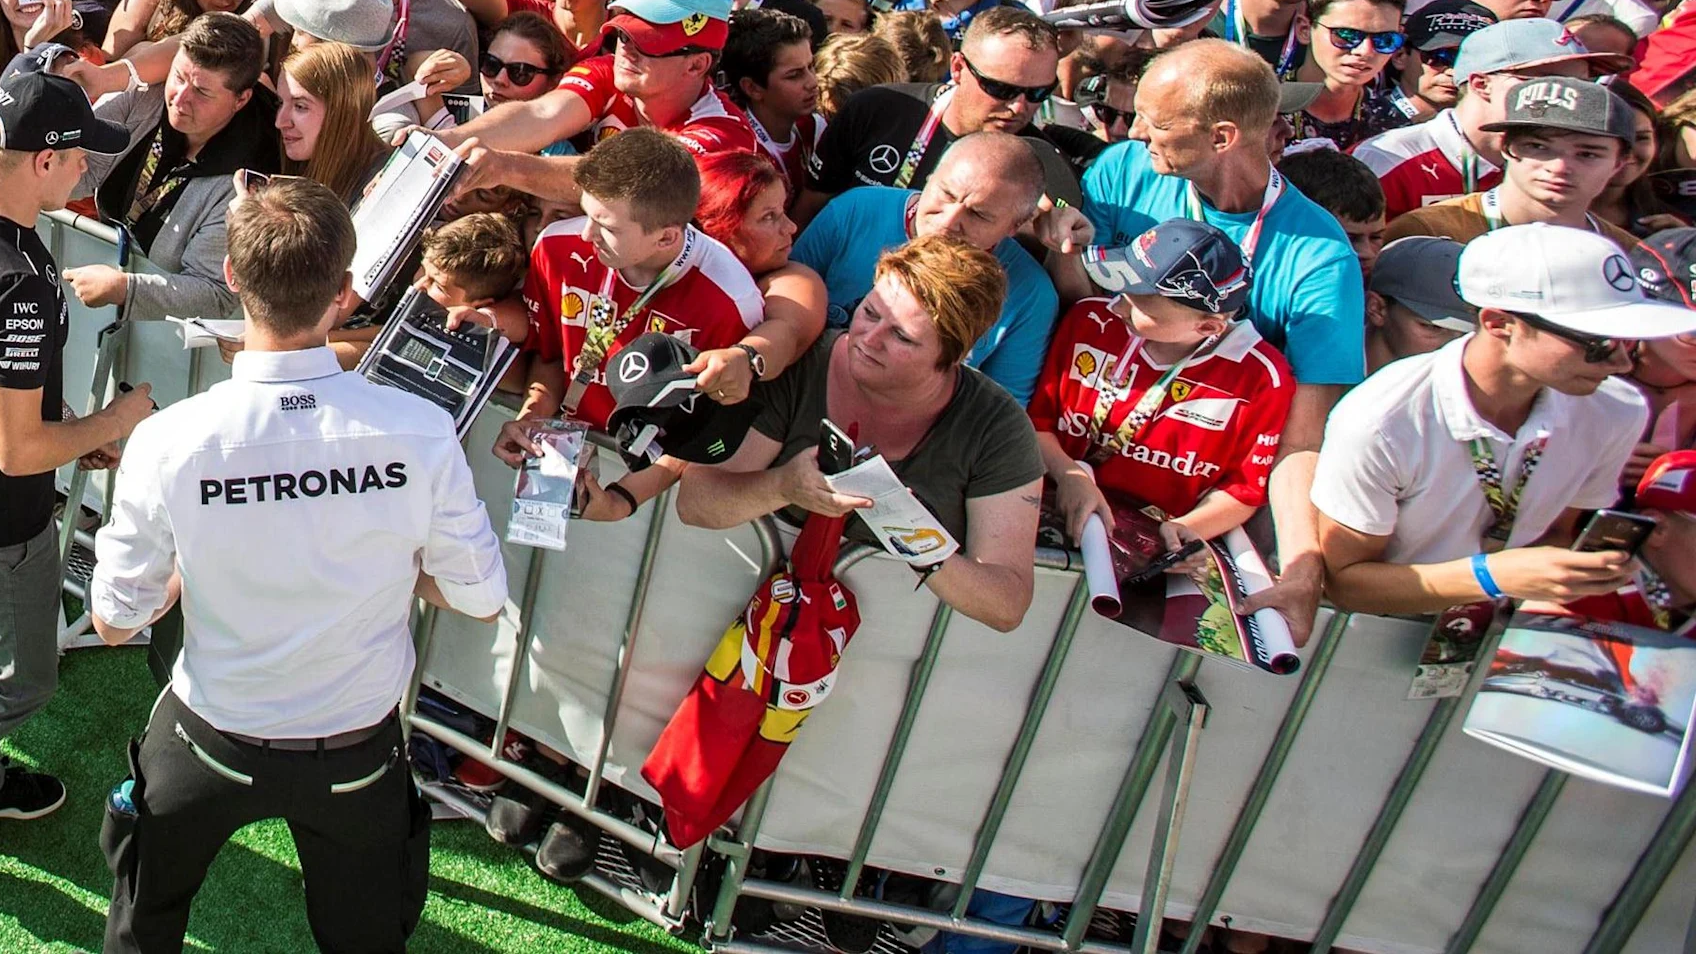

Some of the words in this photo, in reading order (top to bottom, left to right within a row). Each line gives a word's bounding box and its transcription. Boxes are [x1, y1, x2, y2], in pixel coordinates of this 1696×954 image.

[1515, 81, 1579, 111] BULLS
[1098, 259, 1142, 289] 5
[13, 302, 39, 315] IWC
[5, 318, 44, 331] EPSON
[5, 347, 40, 358] PIRELLI
[11, 361, 41, 371] WIHURI
[280, 394, 316, 407] BOSS
[200, 461, 408, 505] PETRONAS
